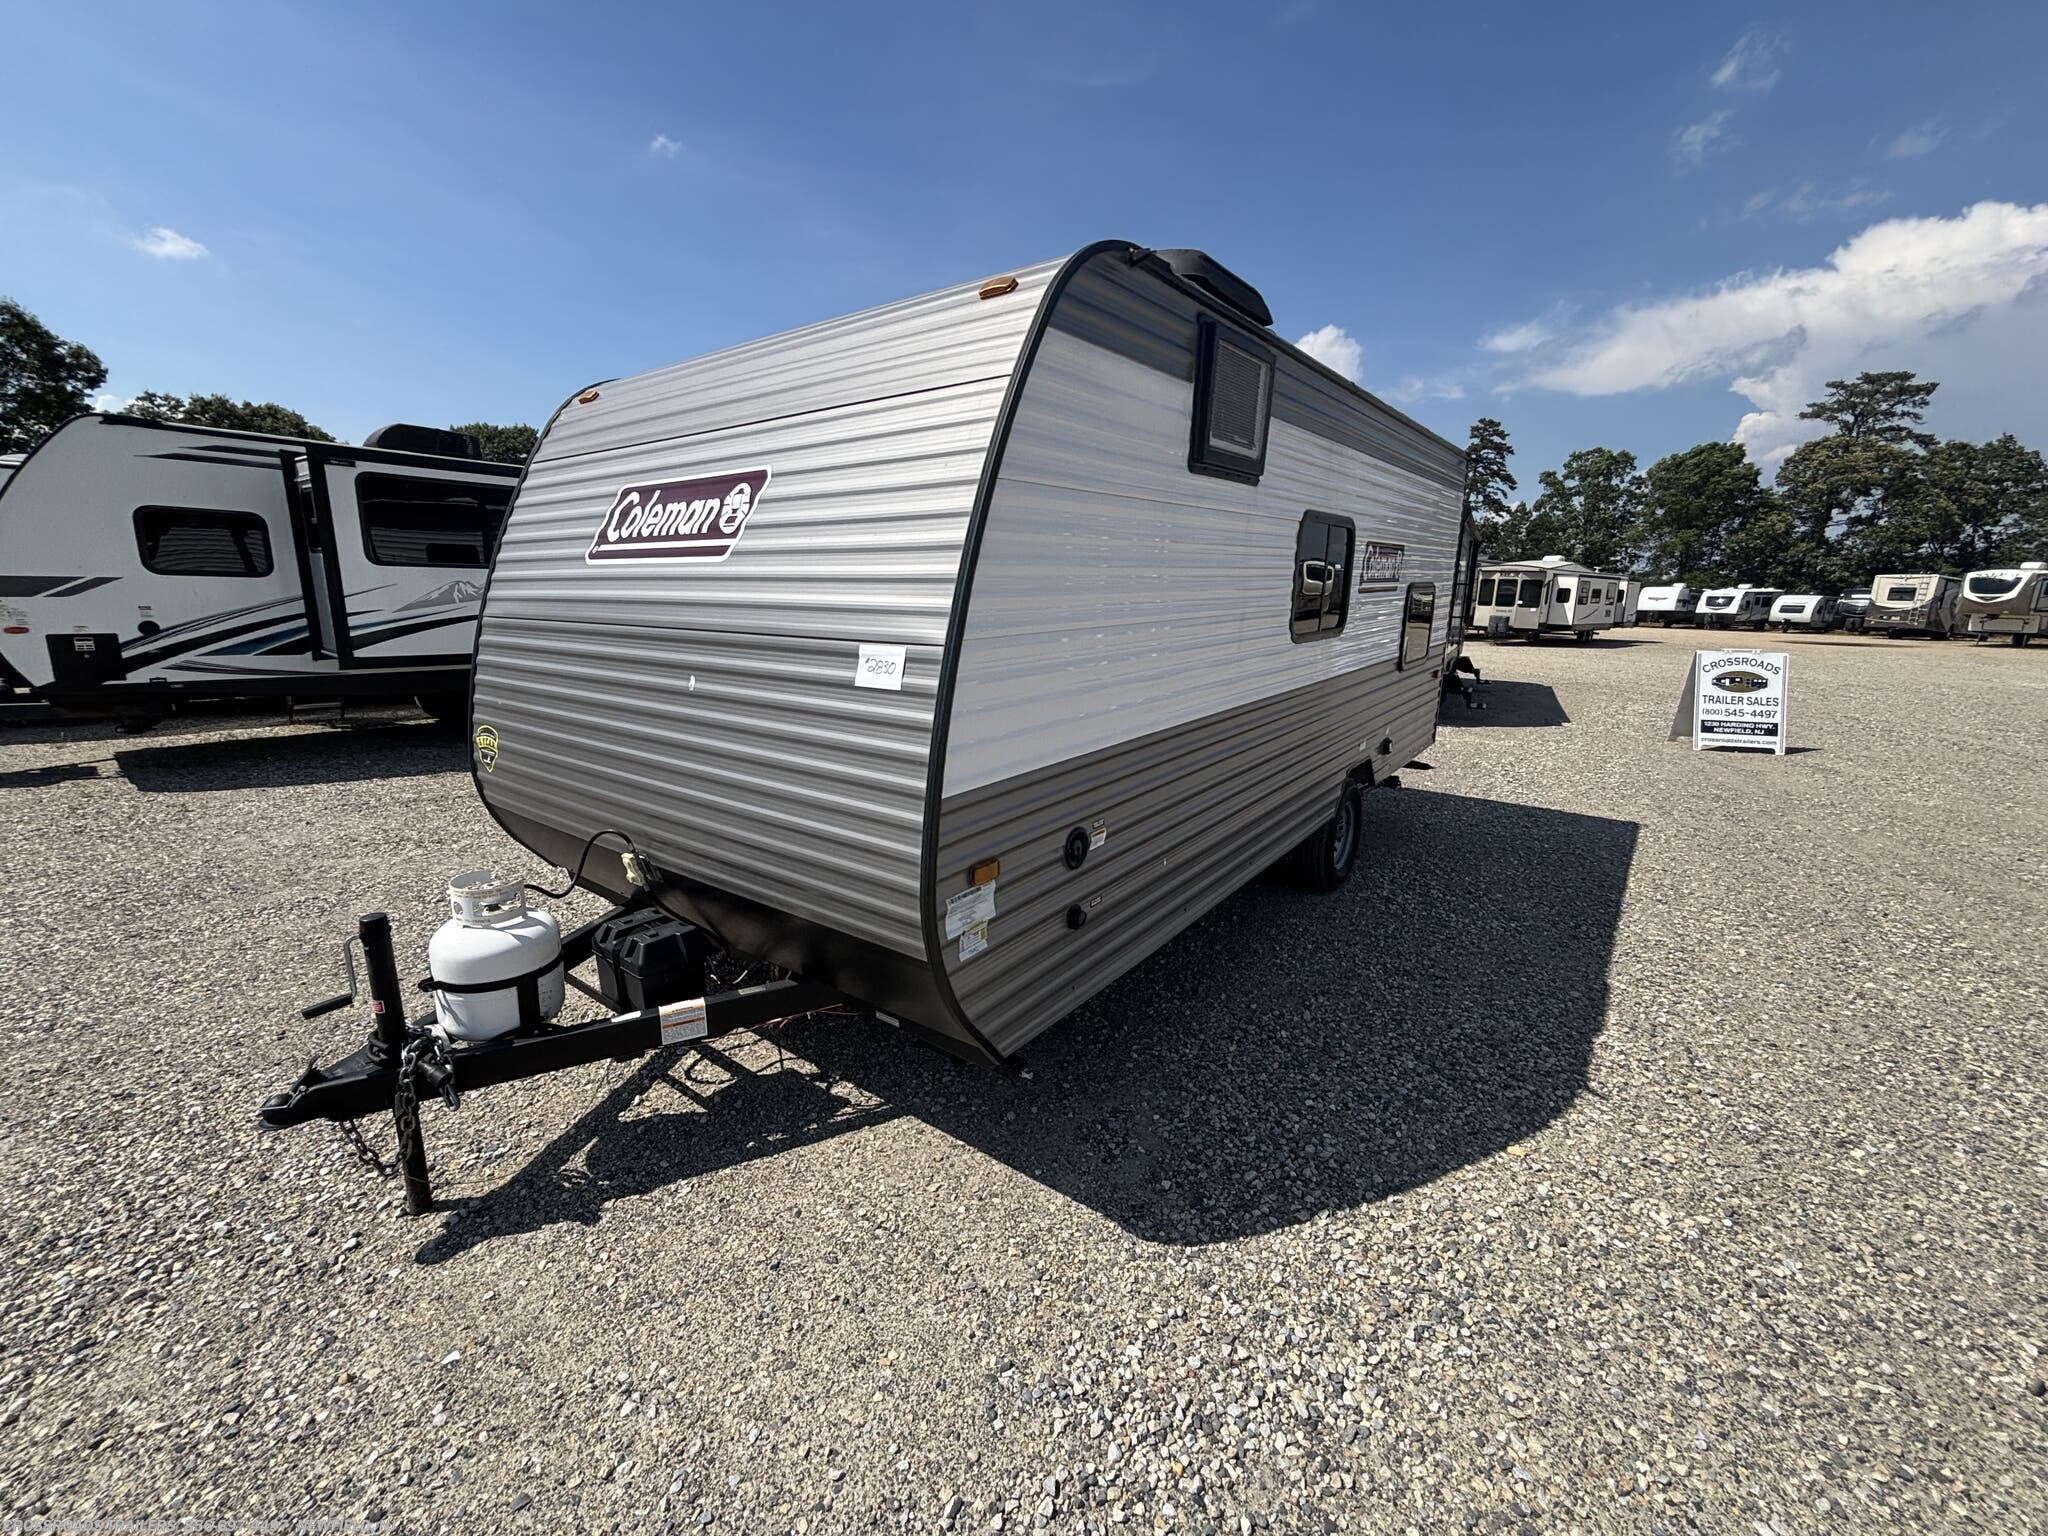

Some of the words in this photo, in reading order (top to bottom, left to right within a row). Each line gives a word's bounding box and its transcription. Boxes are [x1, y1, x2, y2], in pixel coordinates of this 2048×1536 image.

[607, 490, 721, 542] Coleman
[1702, 657, 1782, 675] CROSSROADS
[1702, 694, 1744, 706] TRAILER
[1746, 696, 1779, 707] SALES
[1702, 708, 1723, 716] (800)
[1724, 708, 1778, 719] 545-4497
[1720, 721, 1755, 729] HARDING
